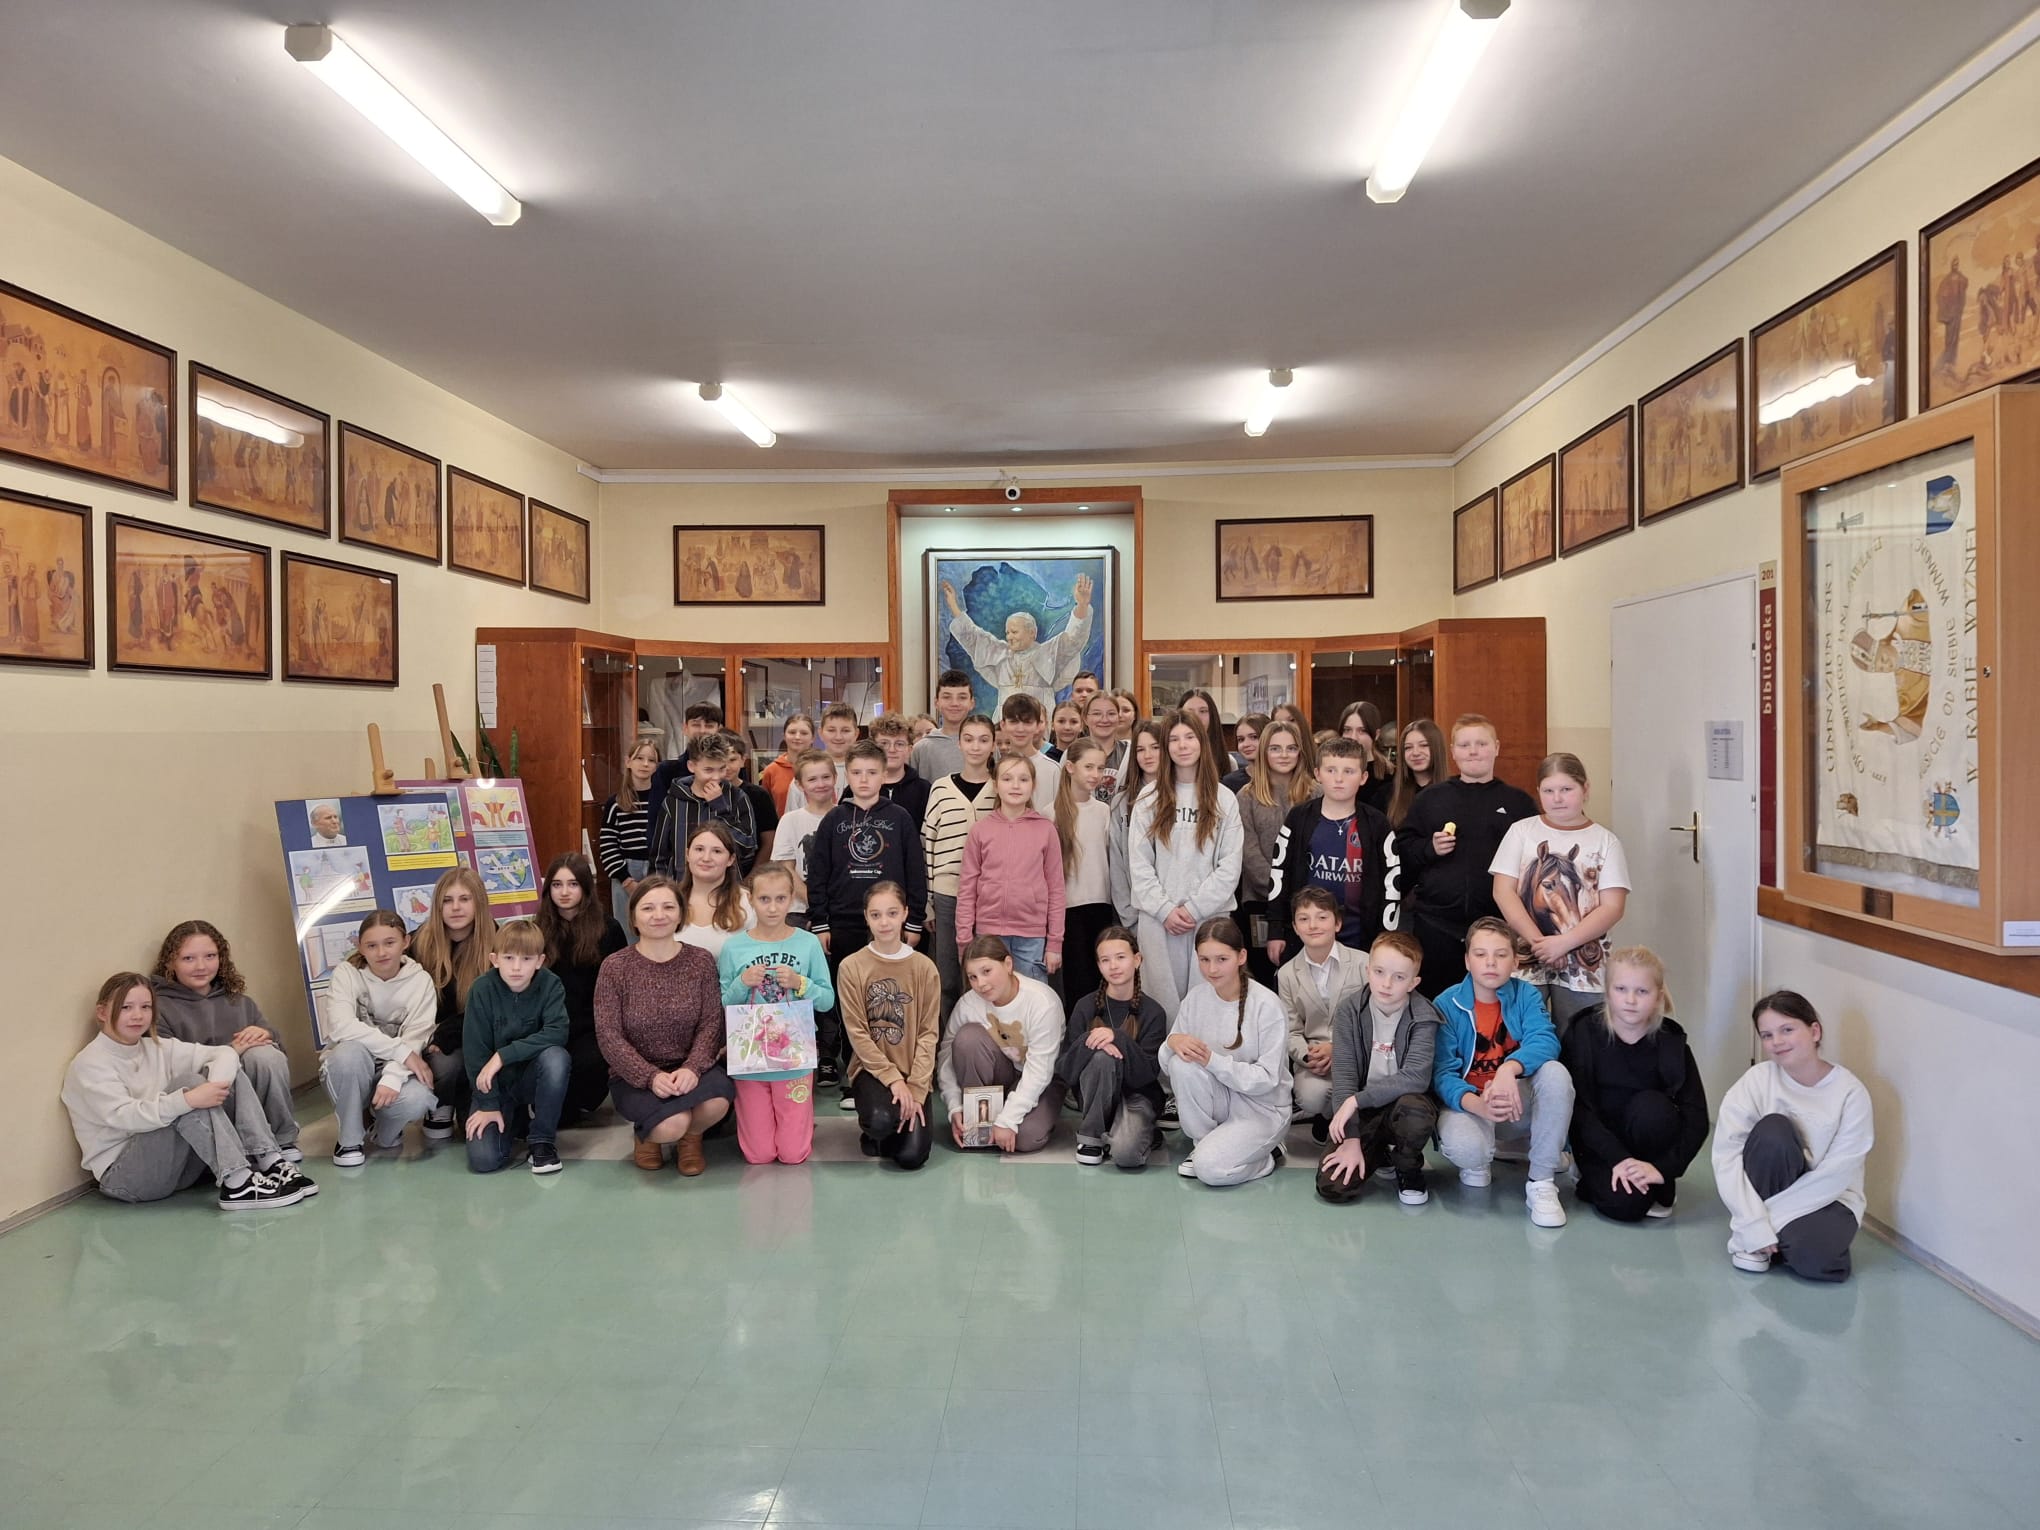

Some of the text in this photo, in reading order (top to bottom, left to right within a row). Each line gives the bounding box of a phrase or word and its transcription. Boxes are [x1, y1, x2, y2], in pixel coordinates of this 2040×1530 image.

[1763, 603, 1772, 714] biblioteka
[1945, 616, 1959, 678] SIEBIE
[1942, 690, 1955, 717] OD
[1964, 656, 1977, 741] RABIE
[1313, 869, 1362, 883] AIRWAYS
[781, 953, 796, 967] BE
